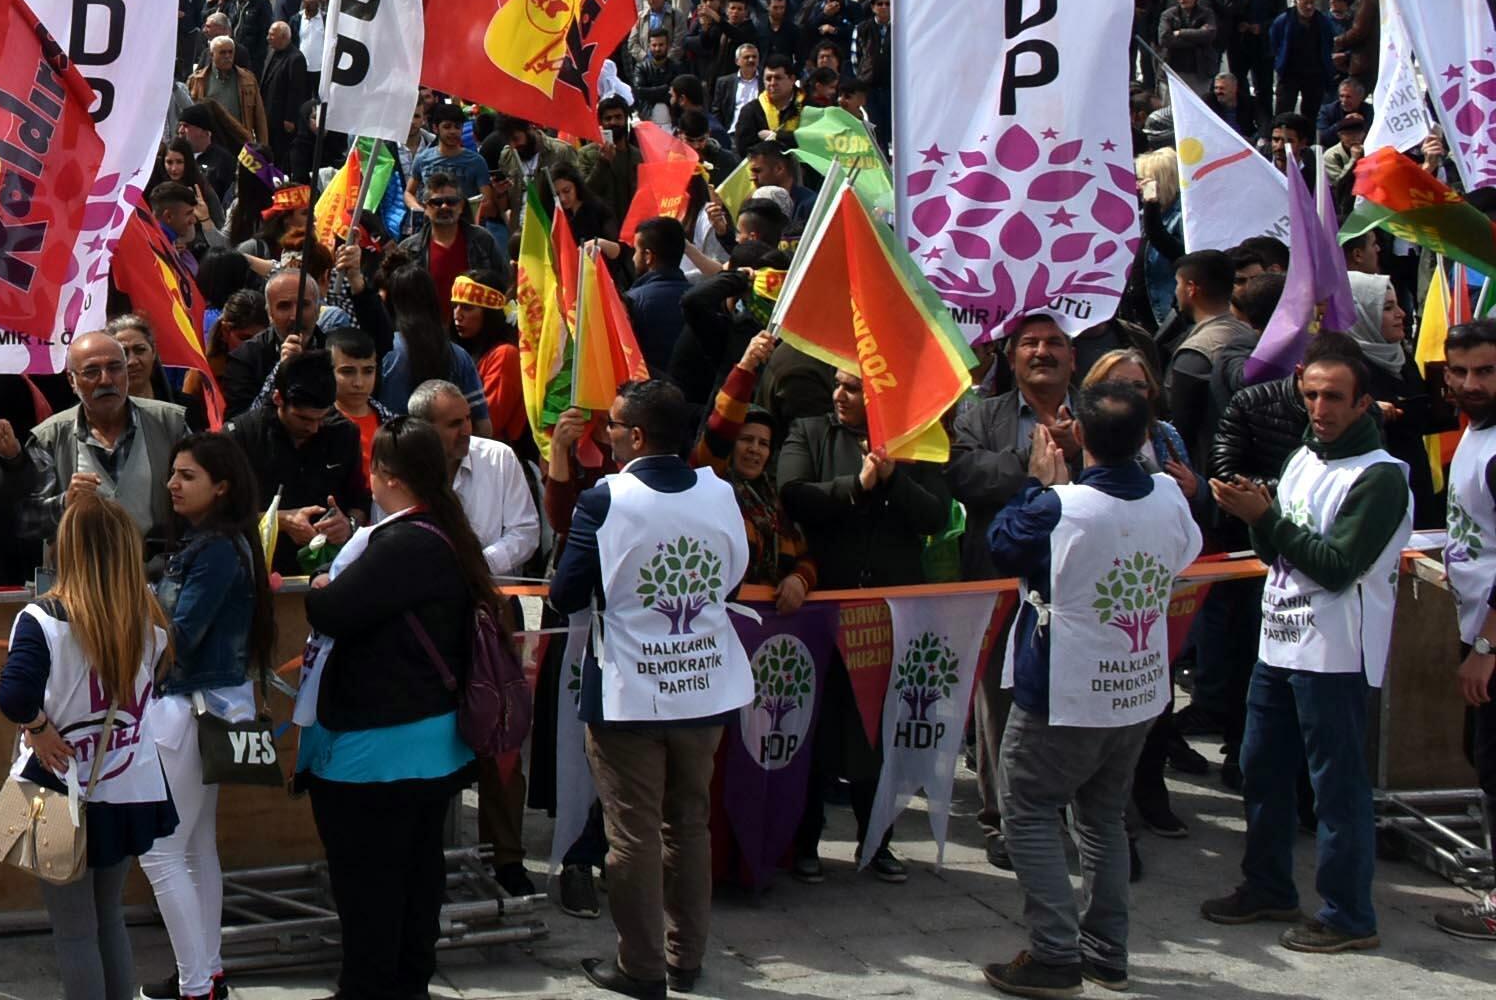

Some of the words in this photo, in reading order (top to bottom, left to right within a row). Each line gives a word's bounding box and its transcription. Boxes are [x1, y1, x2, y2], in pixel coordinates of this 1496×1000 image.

[642, 635, 718, 657] HALKLARIN
[637, 653, 722, 675] DEMOKRATİK
[659, 673, 710, 695] PARTİSİ
[1112, 685, 1156, 711] PARTİSİ
[227, 730, 277, 764] YES
[759, 733, 798, 763] HDP
[894, 721, 946, 749] HDP
